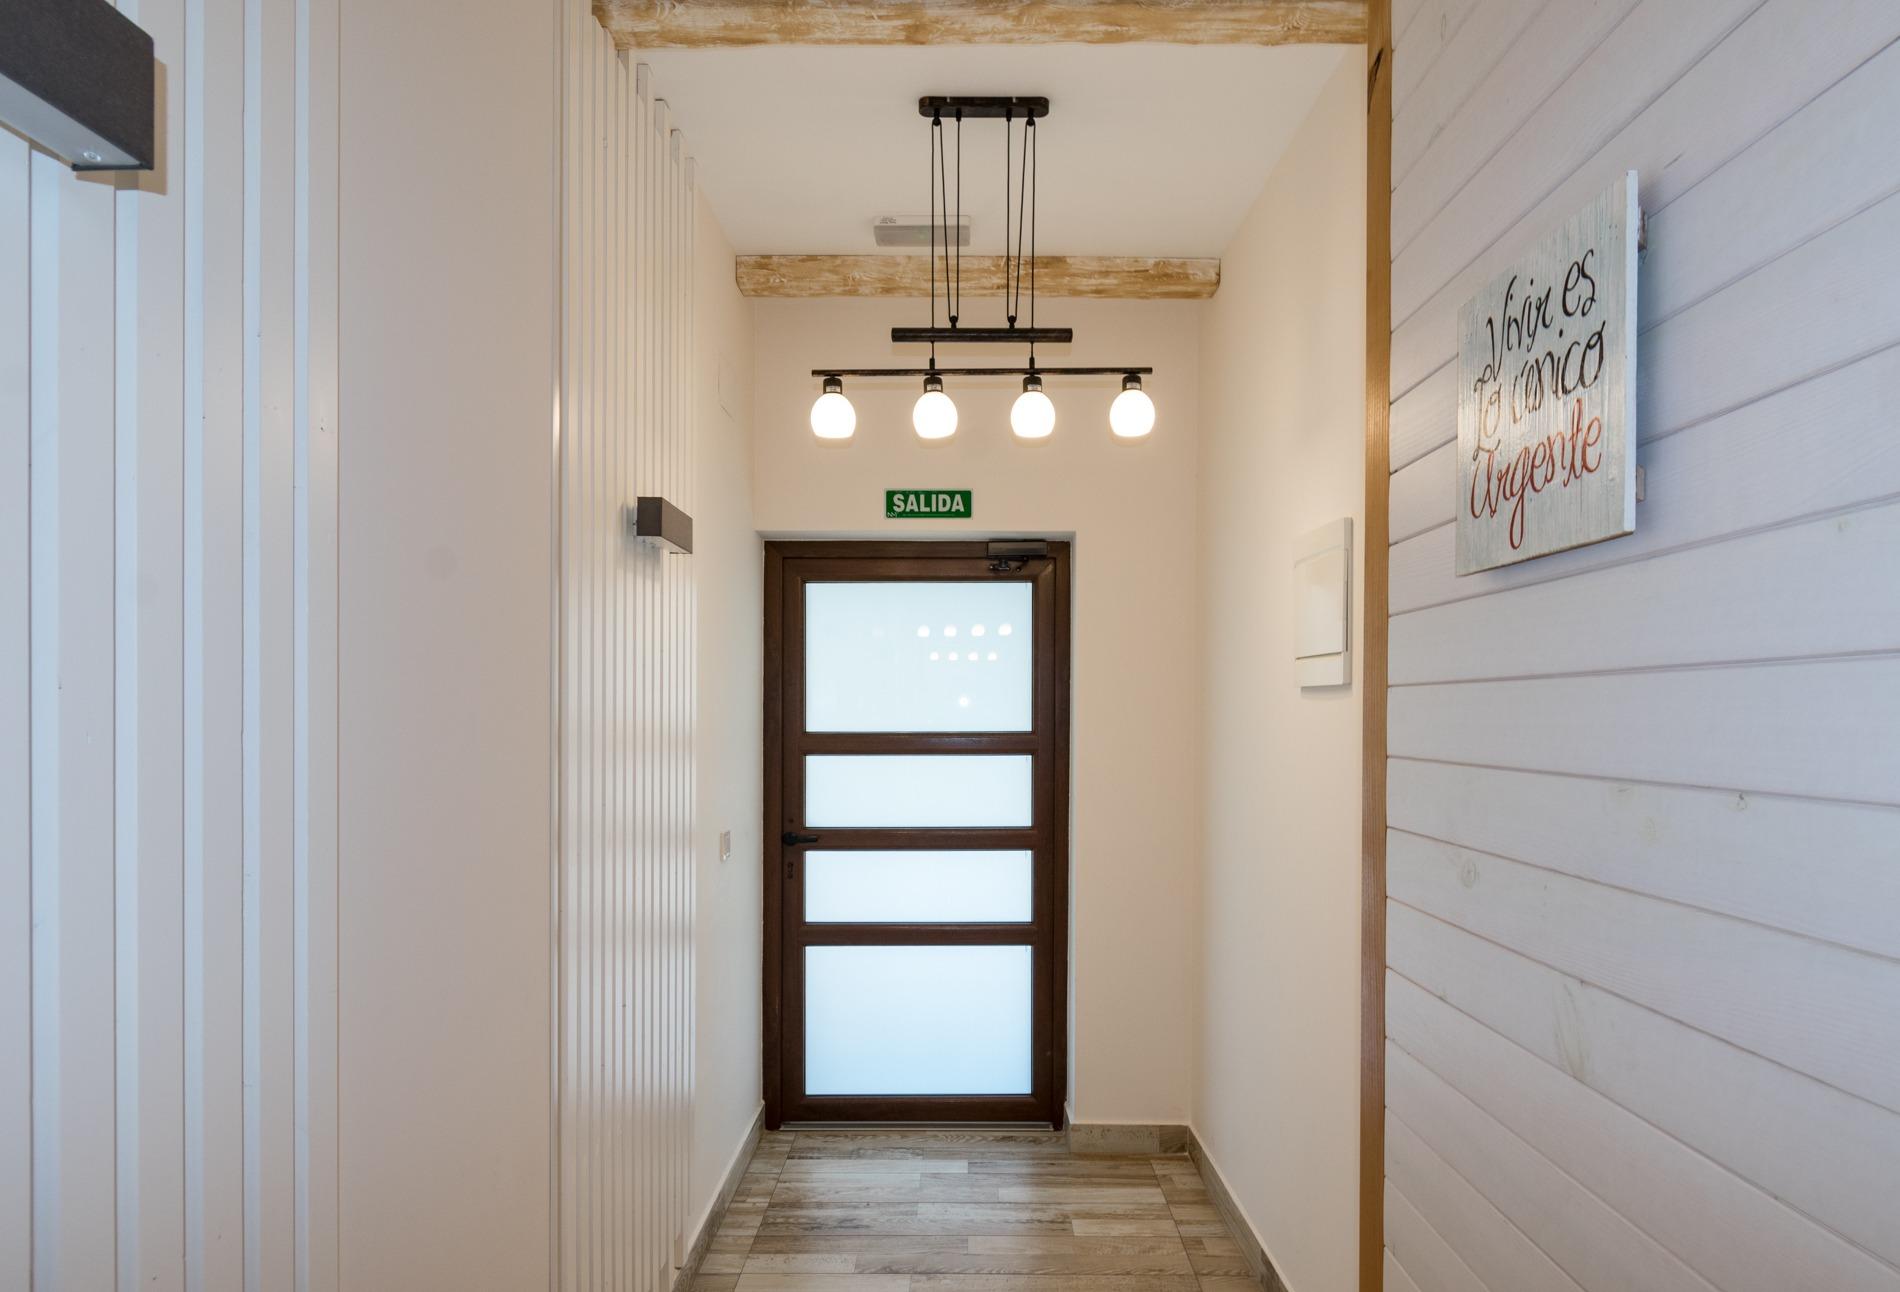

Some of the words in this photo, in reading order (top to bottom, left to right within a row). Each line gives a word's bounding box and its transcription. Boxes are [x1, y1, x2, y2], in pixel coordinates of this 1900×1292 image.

[1486, 275, 1553, 378] Vivir
[1562, 248, 1596, 318] es
[1511, 320, 1606, 424] único
[893, 493, 965, 512] SALIDA
